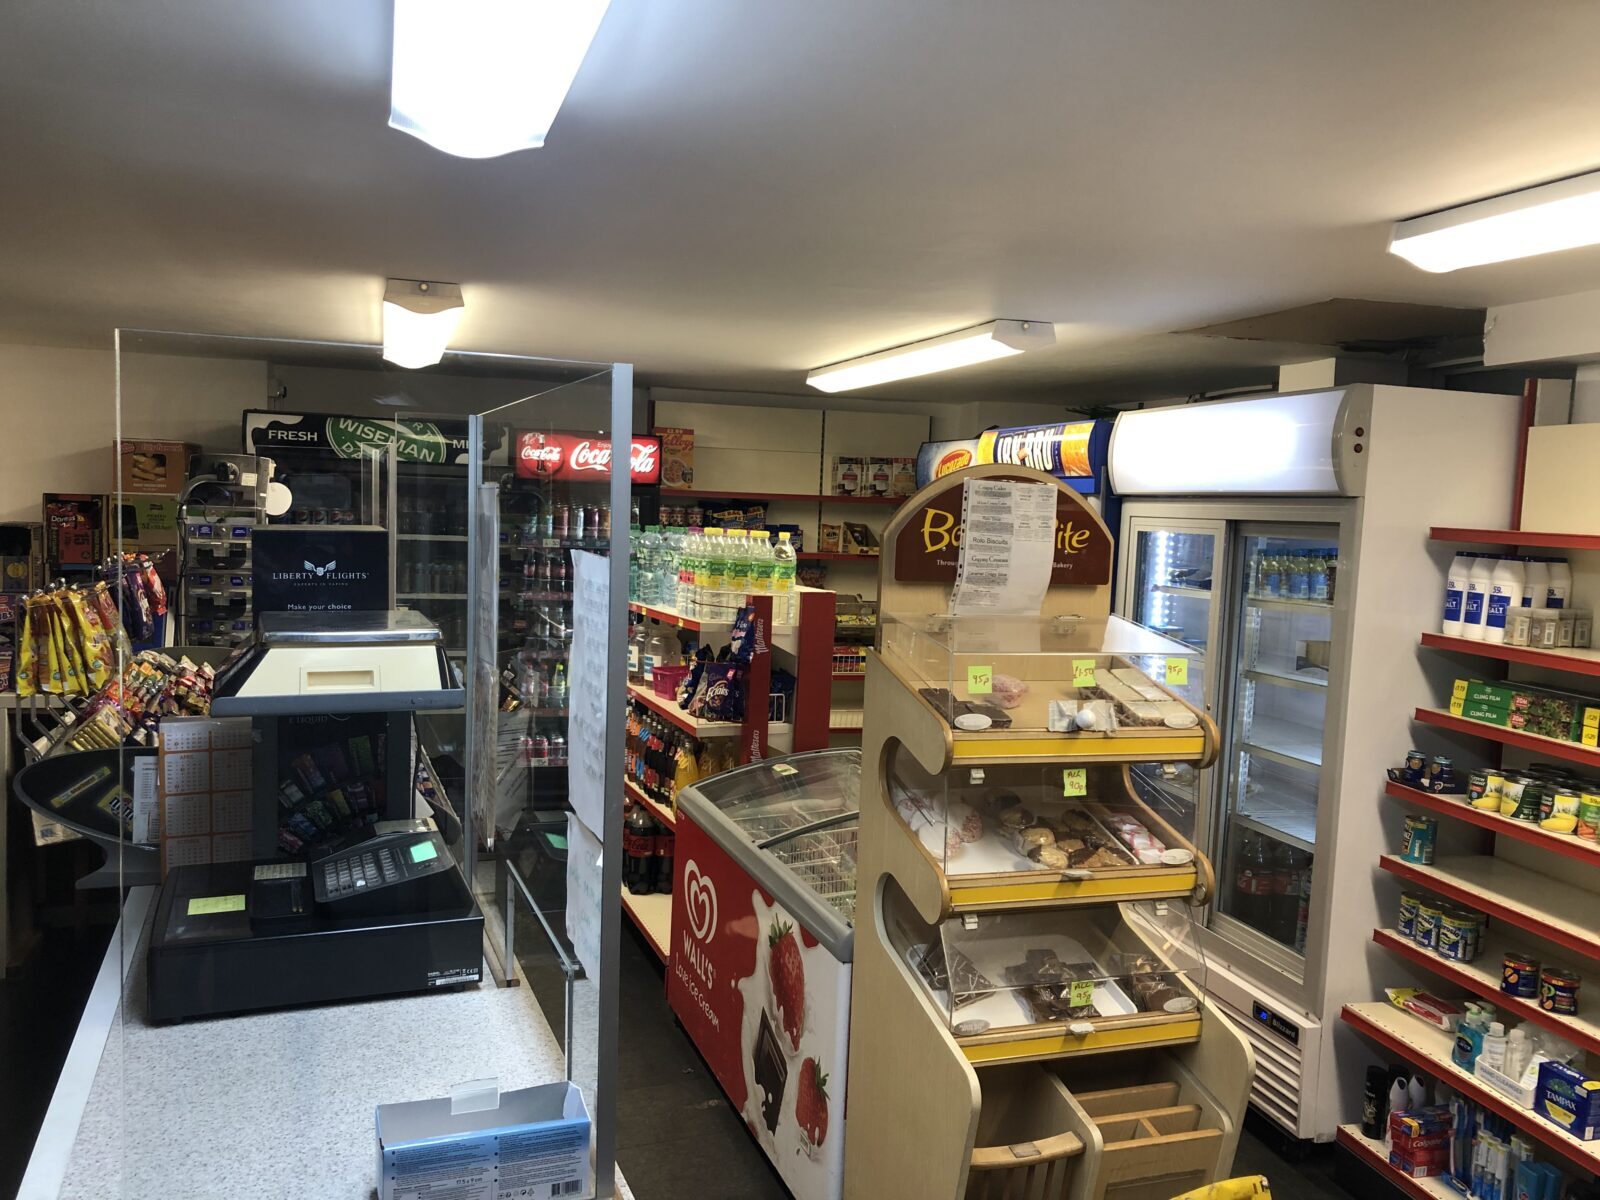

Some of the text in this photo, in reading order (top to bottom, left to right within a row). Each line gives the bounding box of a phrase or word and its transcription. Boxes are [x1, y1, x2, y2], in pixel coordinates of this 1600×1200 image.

[268, 429, 318, 442] FRESH
[338, 418, 435, 463] WISEMAN
[452, 438, 488, 450] MIK
[273, 572, 313, 580] LIBERTY
[308, 604, 325, 612] your
[1073, 666, 1094, 679] £1.50
[1167, 664, 1183, 675] 95p
[972, 673, 989, 686] 95p
[1470, 710, 1485, 718] CLING
[683, 930, 713, 990] WALL'S
[676, 952, 689, 987] Love
[689, 974, 699, 1001] ice
[1546, 1090, 1577, 1111] TAMPAX
